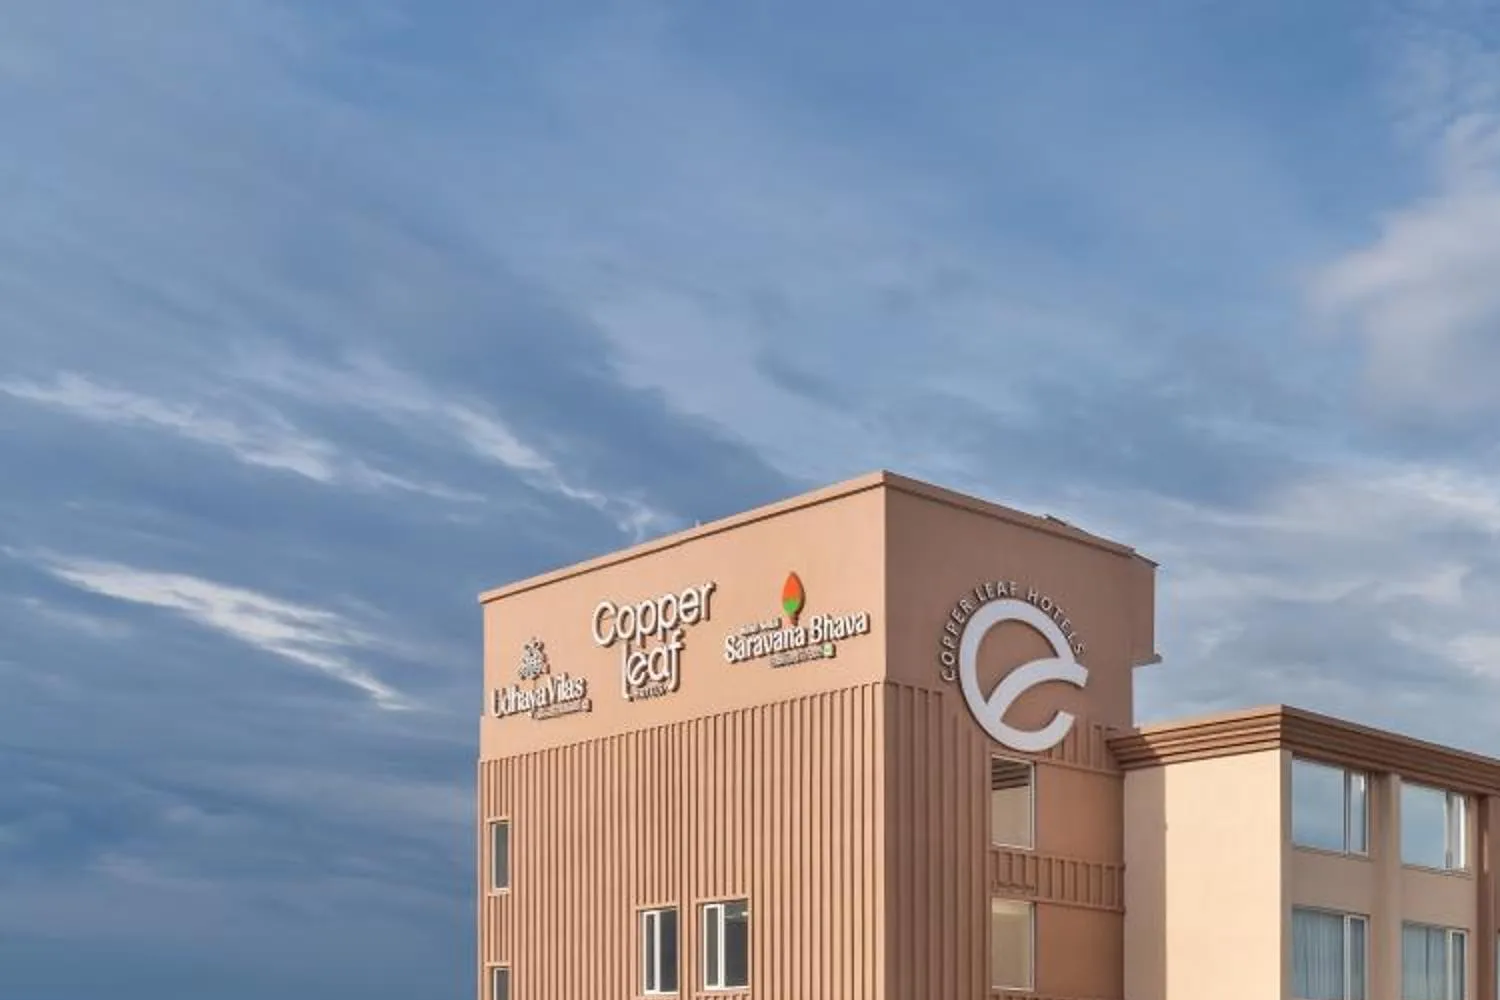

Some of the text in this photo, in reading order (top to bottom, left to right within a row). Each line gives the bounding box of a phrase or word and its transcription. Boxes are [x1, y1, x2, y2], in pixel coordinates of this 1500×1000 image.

[593, 581, 716, 648] Copper
[724, 624, 808, 664] Saravana
[809, 611, 870, 644] Bhava
[941, 581, 1086, 681] COPPER LEAF HOTELS
[622, 628, 686, 701] leaf
